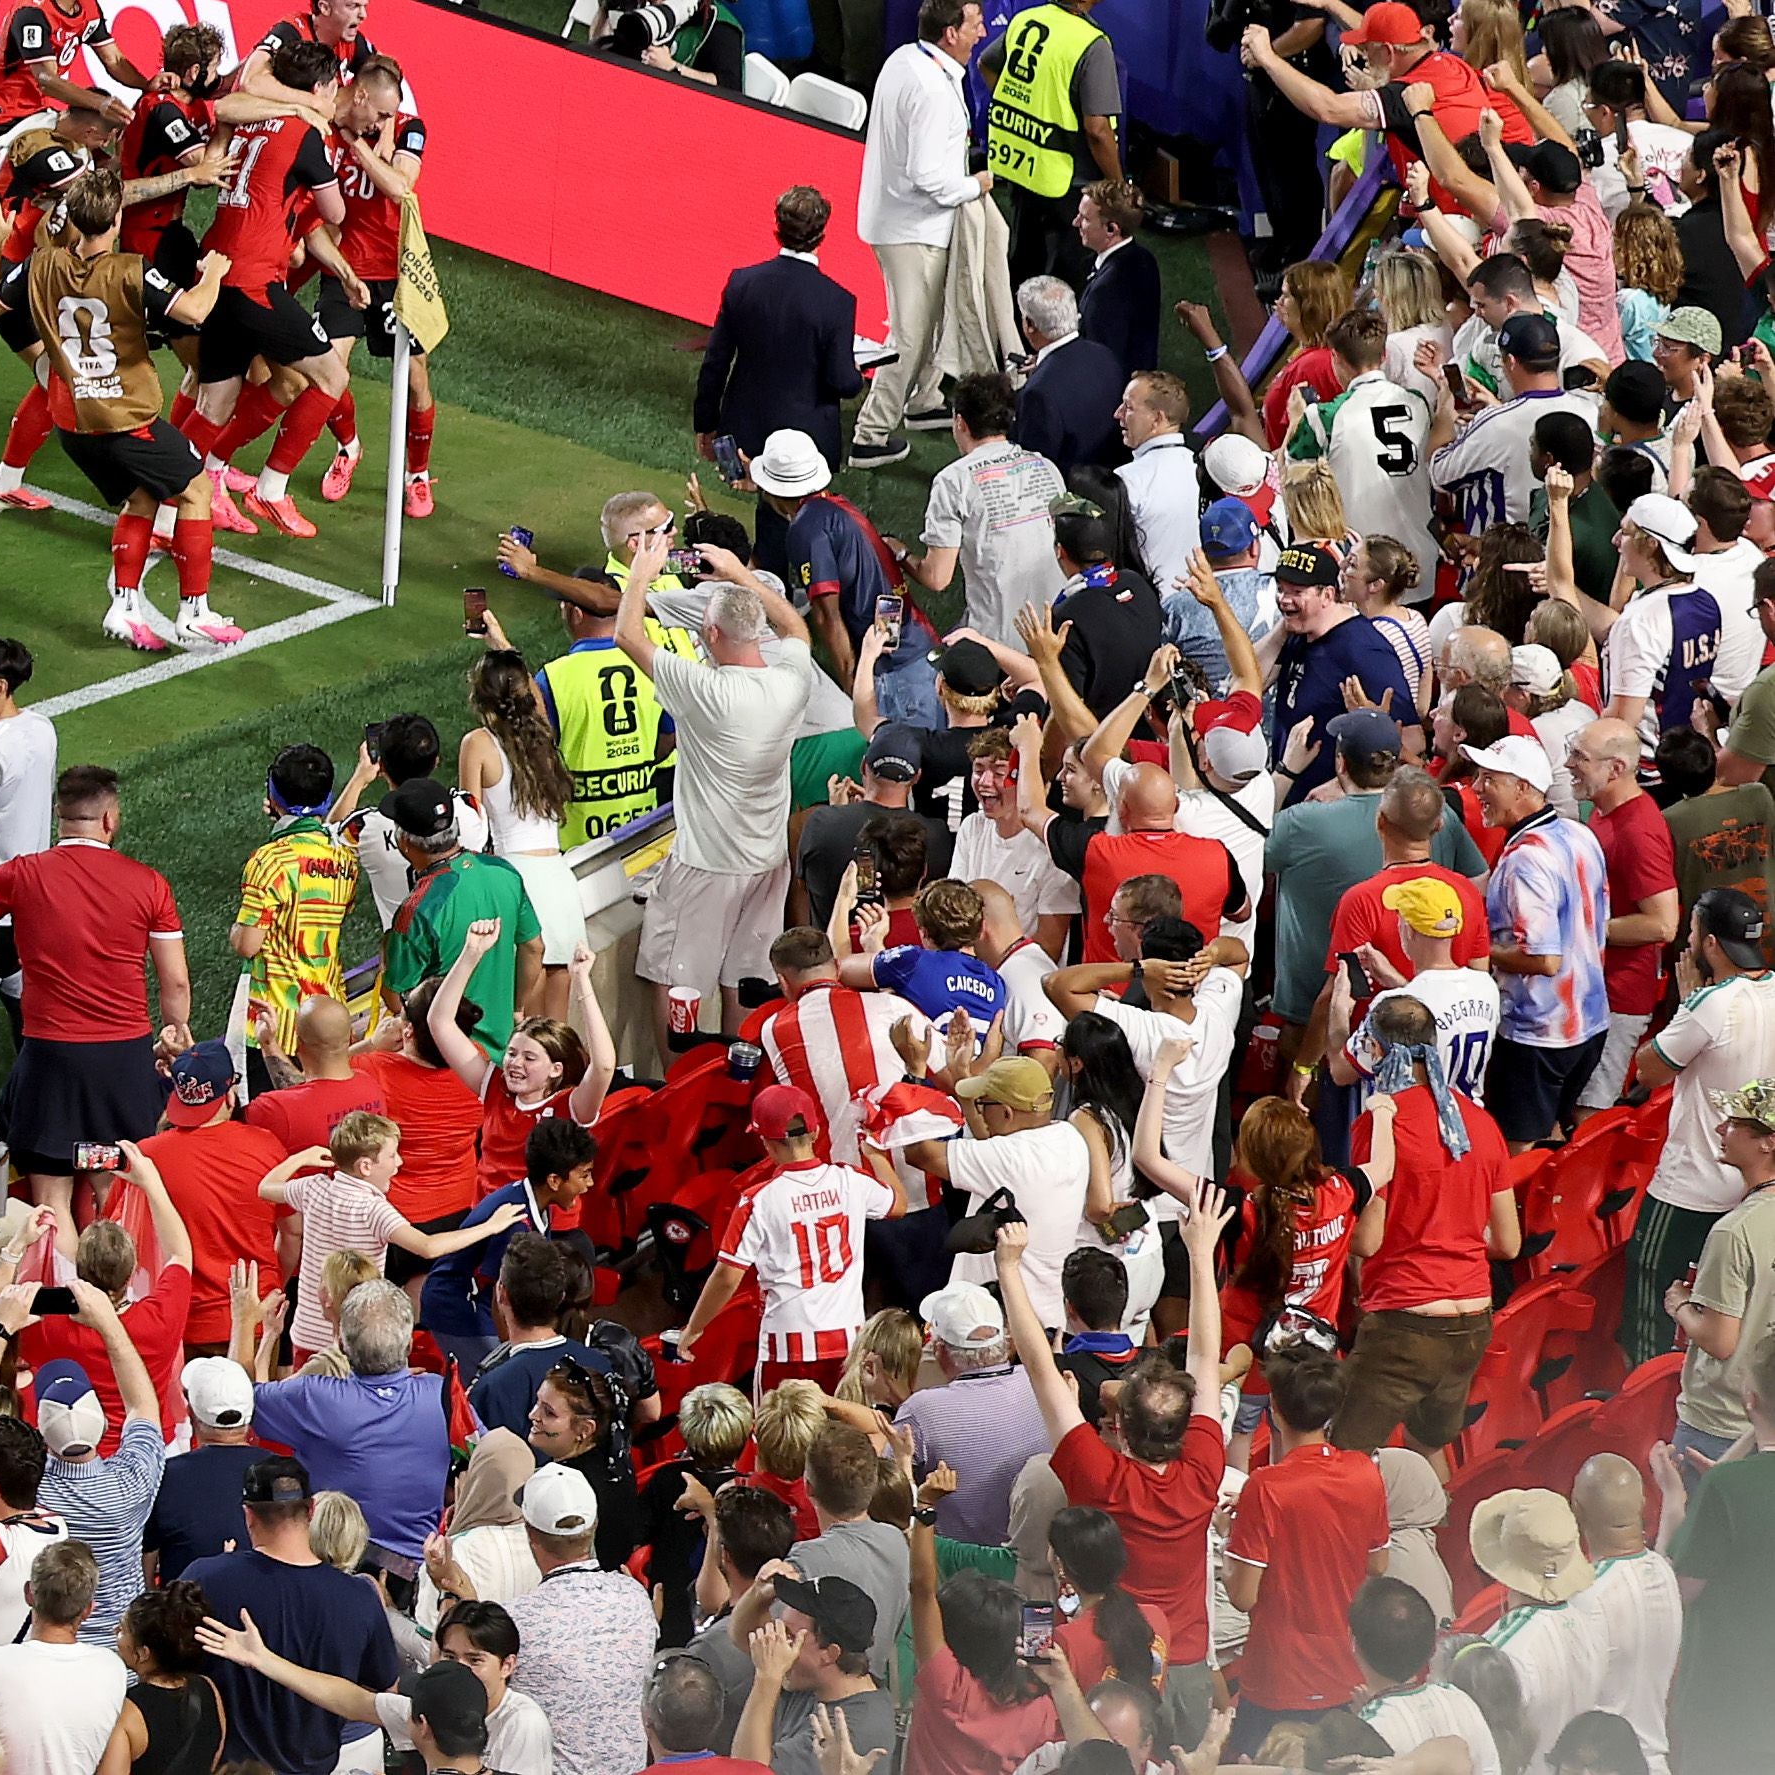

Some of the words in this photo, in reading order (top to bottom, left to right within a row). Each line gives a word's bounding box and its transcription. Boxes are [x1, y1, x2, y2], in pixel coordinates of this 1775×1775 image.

[988, 104, 1054, 146] CURITY
[343, 165, 375, 200] 20
[401, 262, 434, 304] 2026
[78, 361, 103, 371] FIFA
[100, 375, 121, 387] CUP
[74, 385, 124, 399] 2026
[1370, 404, 1419, 477] 5
[968, 458, 991, 472] FIFA
[606, 744, 641, 759] 2026
[575, 774, 657, 804] SECURIY
[945, 975, 996, 1002] CAICEDO
[1446, 1029, 1490, 1101] 10
[1292, 1216, 1345, 1251] AUTOVIC
[792, 1212, 850, 1290] 10
